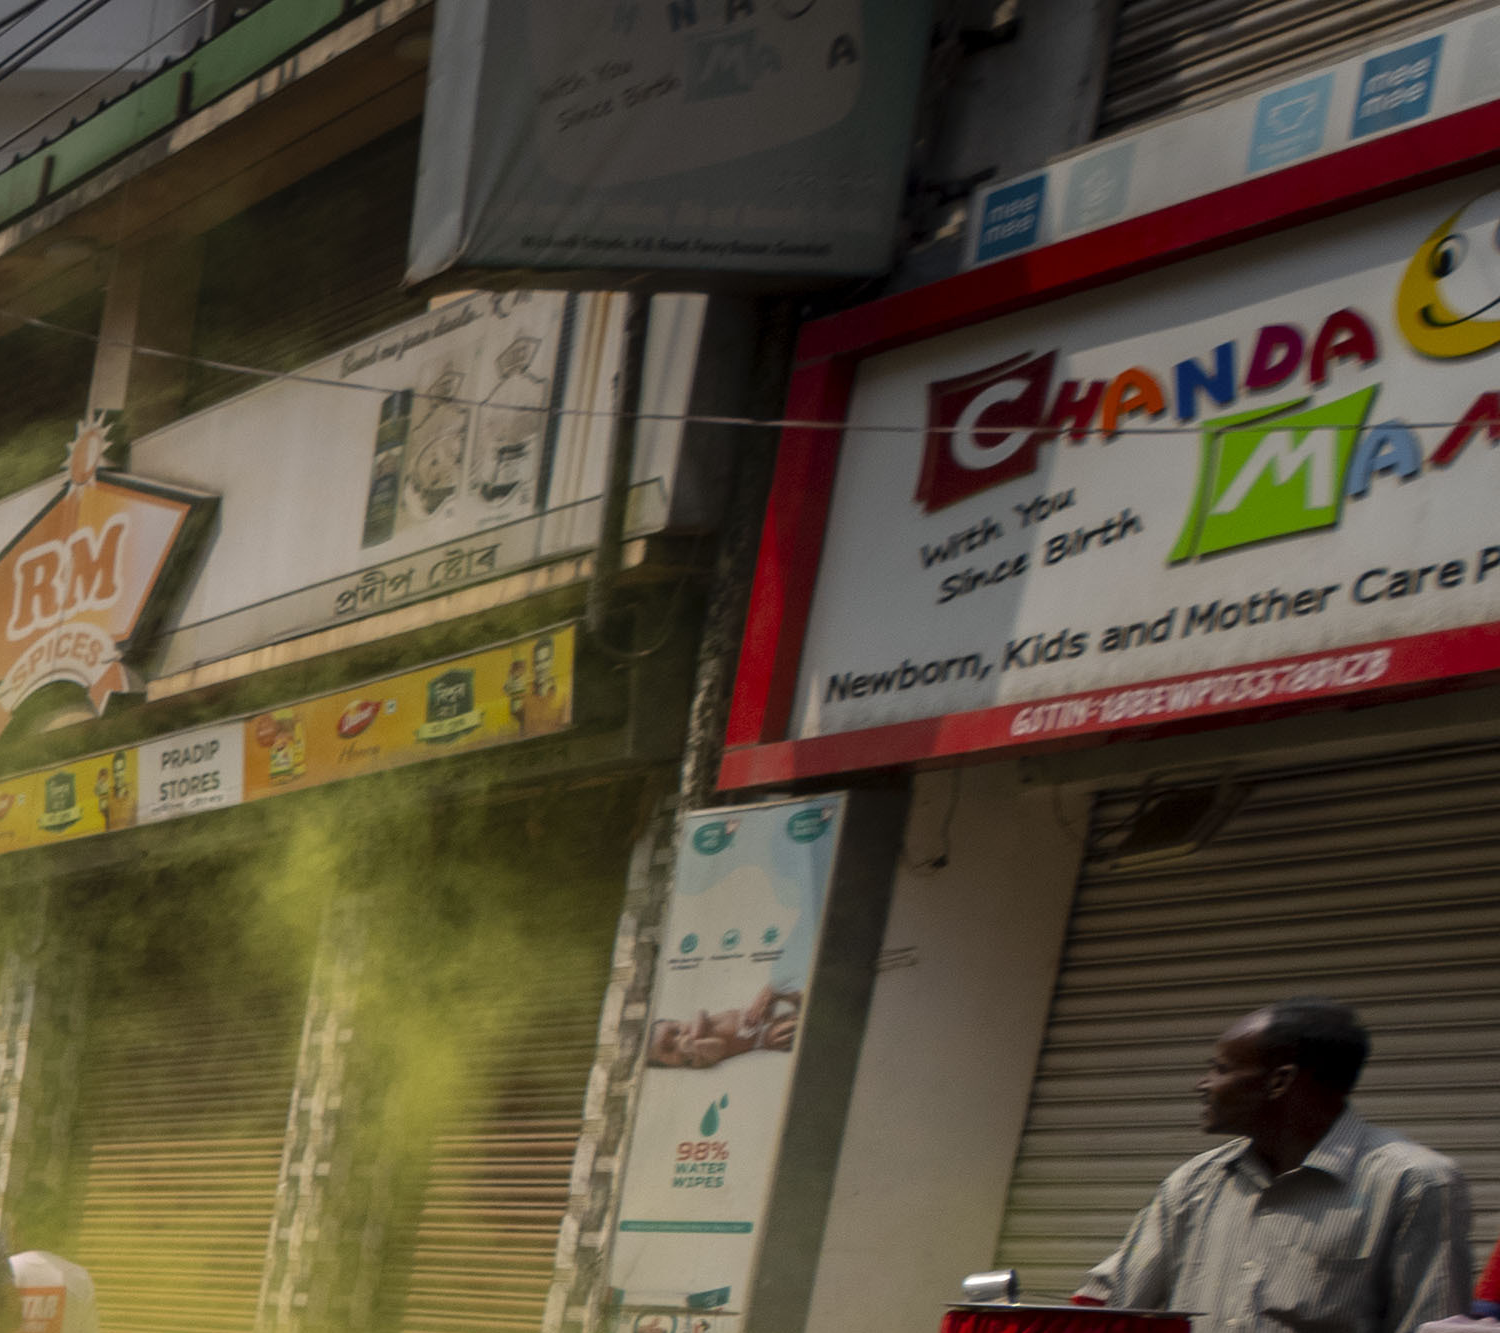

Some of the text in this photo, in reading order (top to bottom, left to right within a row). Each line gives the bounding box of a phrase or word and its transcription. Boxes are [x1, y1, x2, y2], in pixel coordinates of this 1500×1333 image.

[1364, 55, 1432, 92] mee
[1360, 79, 1428, 118] mee
[987, 191, 1037, 224] mee
[984, 214, 1035, 246] mee
[950, 306, 1379, 470] CHANDA
[920, 487, 1077, 569] With You
[937, 507, 1145, 605] Since Birth
[10, 517, 123, 639] RM
[825, 650, 994, 704] Newborn,
[1002, 618, 1085, 673] Kids
[1099, 602, 1170, 654] and
[1180, 569, 1340, 638] Mother
[1352, 549, 1467, 605] Care
[11, 626, 104, 690] SPICES
[161, 739, 221, 772] PRADIP
[159, 769, 221, 802] STORES
[673, 1162, 728, 1175] WATER
[675, 1141, 730, 1162] 98%
[671, 1176, 725, 1189] WIPES
